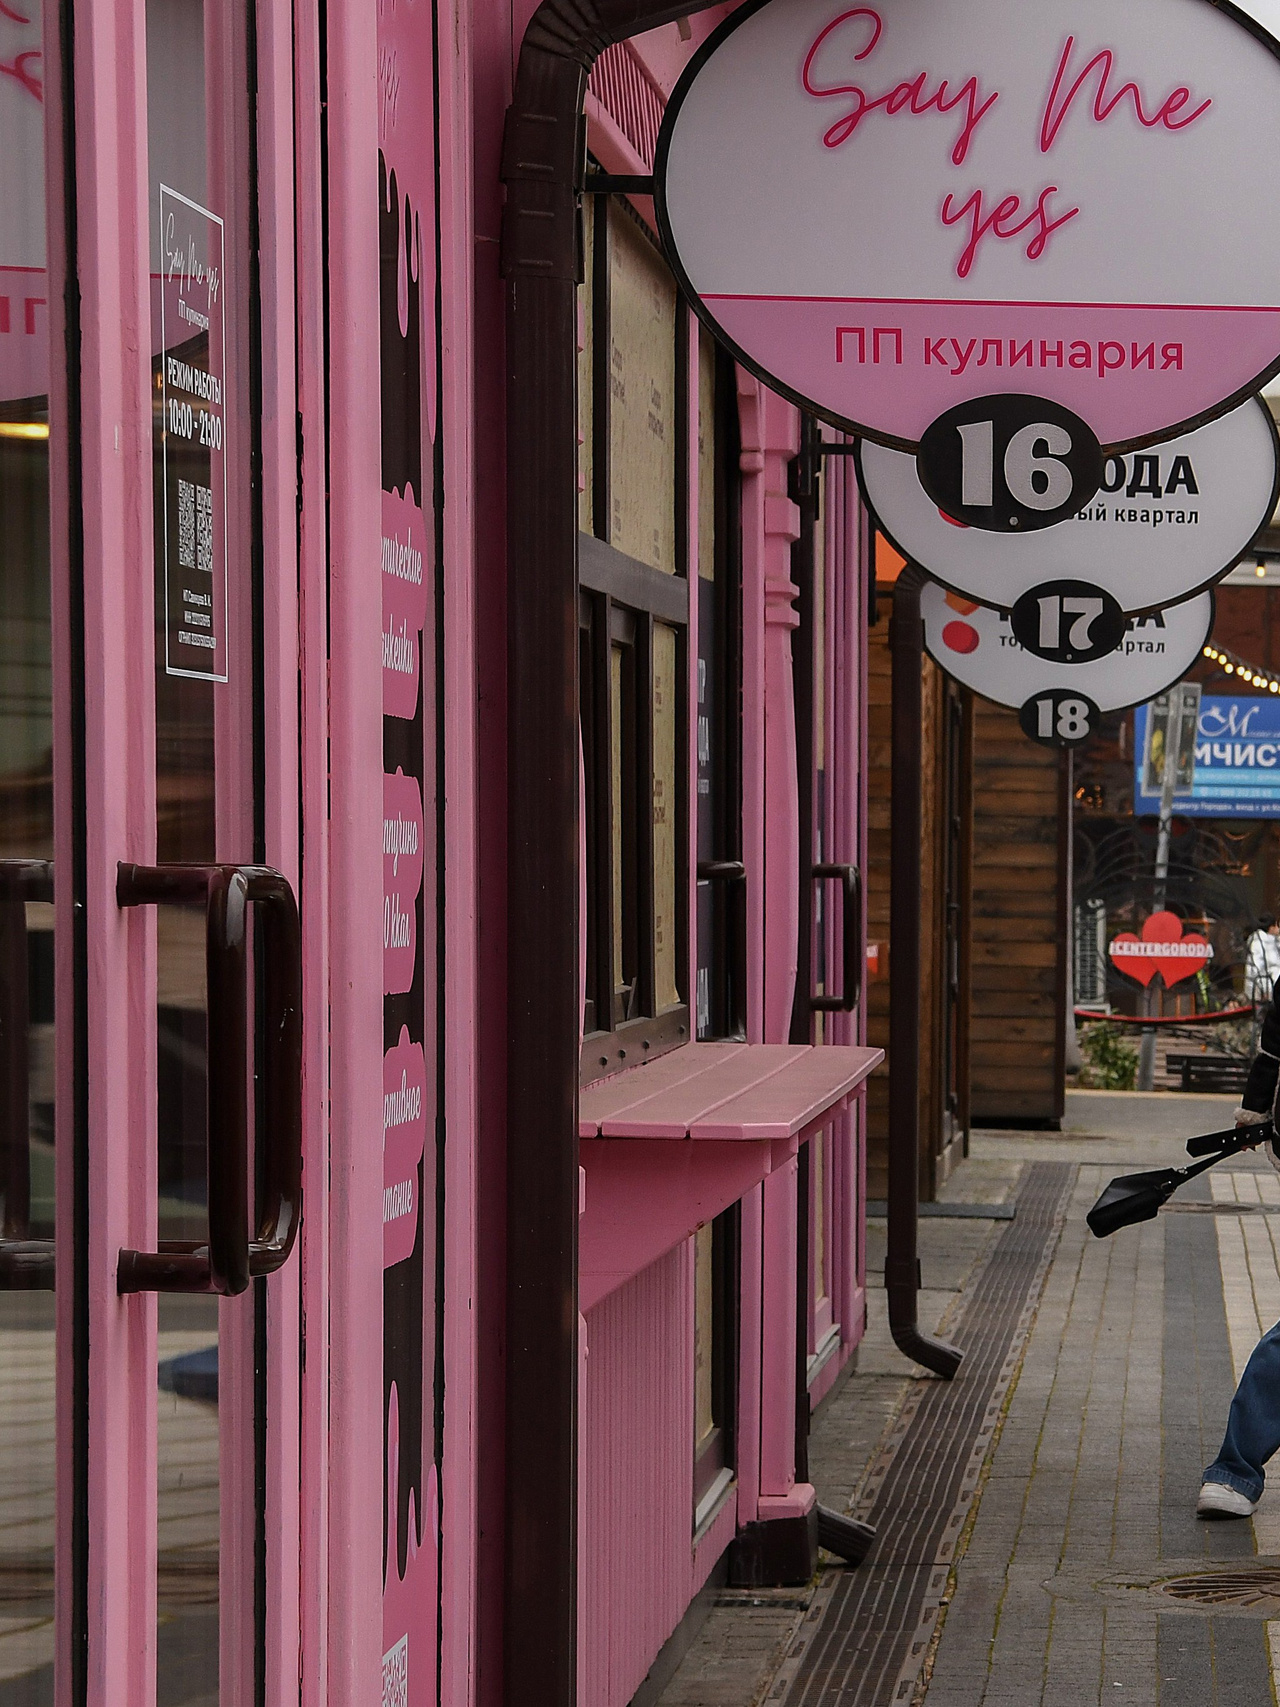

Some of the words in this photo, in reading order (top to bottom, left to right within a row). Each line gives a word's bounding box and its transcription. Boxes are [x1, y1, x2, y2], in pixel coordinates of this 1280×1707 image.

[801, 8, 999, 165] Say
[1038, 35, 1212, 152] Me
[940, 185, 1080, 279] yes
[834, 326, 903, 365] ПП
[922, 331, 1185, 378] кулинария
[167, 356, 194, 394] РЕЖИМ
[194, 367, 222, 405] РАБОТЫ
[168, 397, 193, 440] 10:00
[199, 409, 222, 451] 21:00
[955, 419, 1074, 511] 16
[1100, 454, 1200, 499] ОДА
[1114, 508, 1200, 528] квартал
[381, 527, 423, 586] тические
[1036, 594, 1104, 651] 17
[1115, 640, 1166, 656] артал
[1036, 699, 1090, 739] 18
[383, 811, 419, 877] ппучино
[383, 1069, 421, 1151] ртивное
